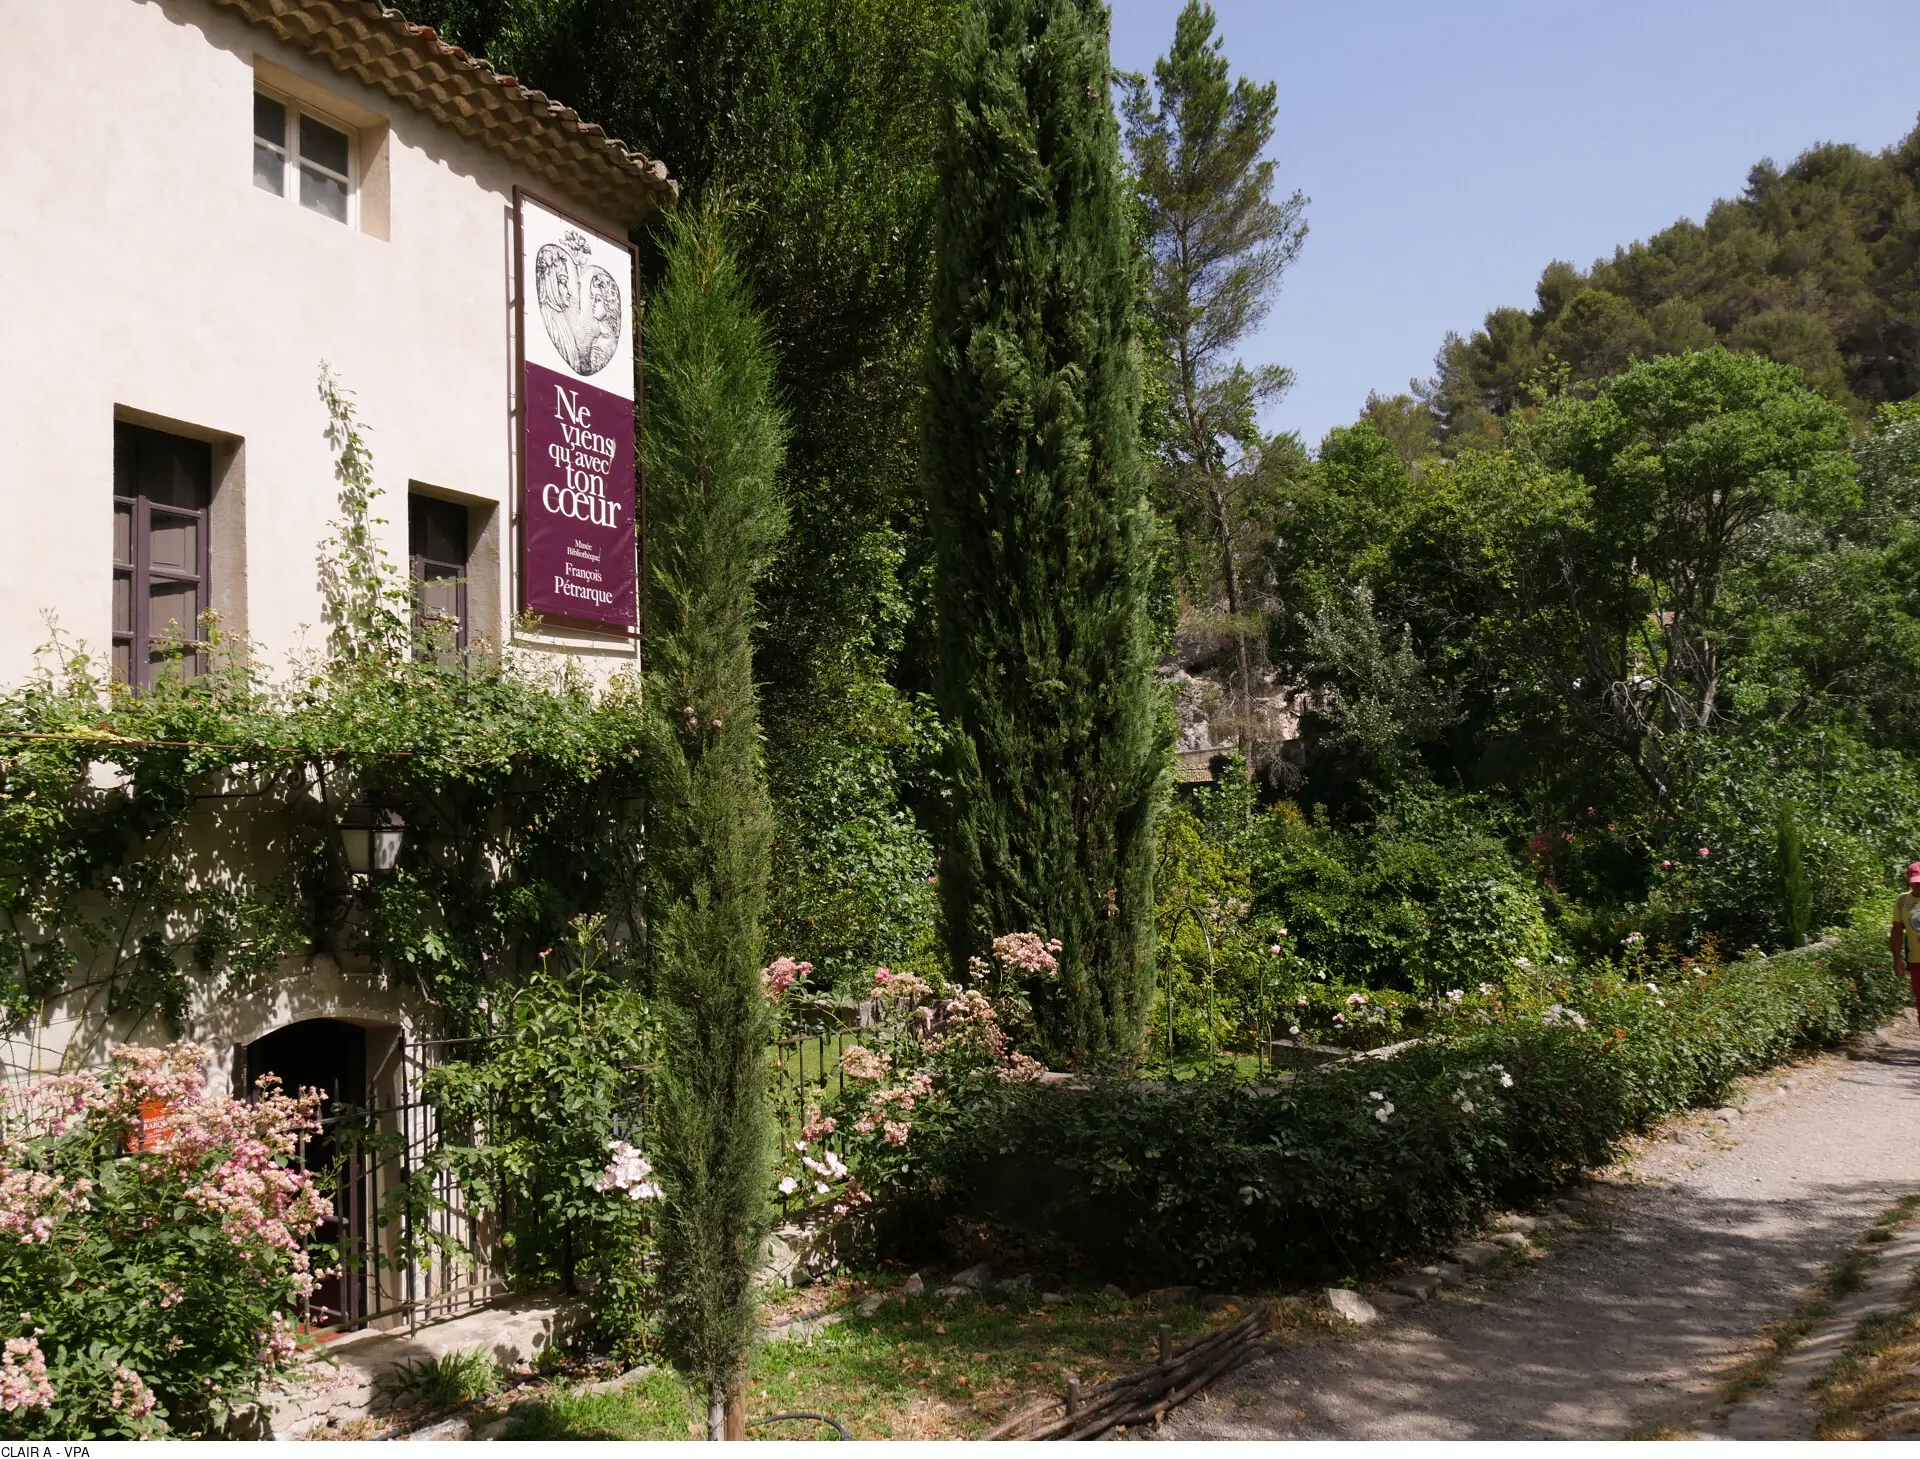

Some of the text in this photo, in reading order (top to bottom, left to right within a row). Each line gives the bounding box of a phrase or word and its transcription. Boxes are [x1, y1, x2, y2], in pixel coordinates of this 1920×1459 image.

[554, 384, 591, 428] Ne
[560, 422, 616, 458] viens
[566, 461, 605, 498] ton
[542, 483, 622, 528] cœur
[567, 546, 600, 562] Bibliothèque
[575, 539, 592, 551] Musée
[565, 562, 602, 582] François
[554, 575, 613, 606] Pétrarque
